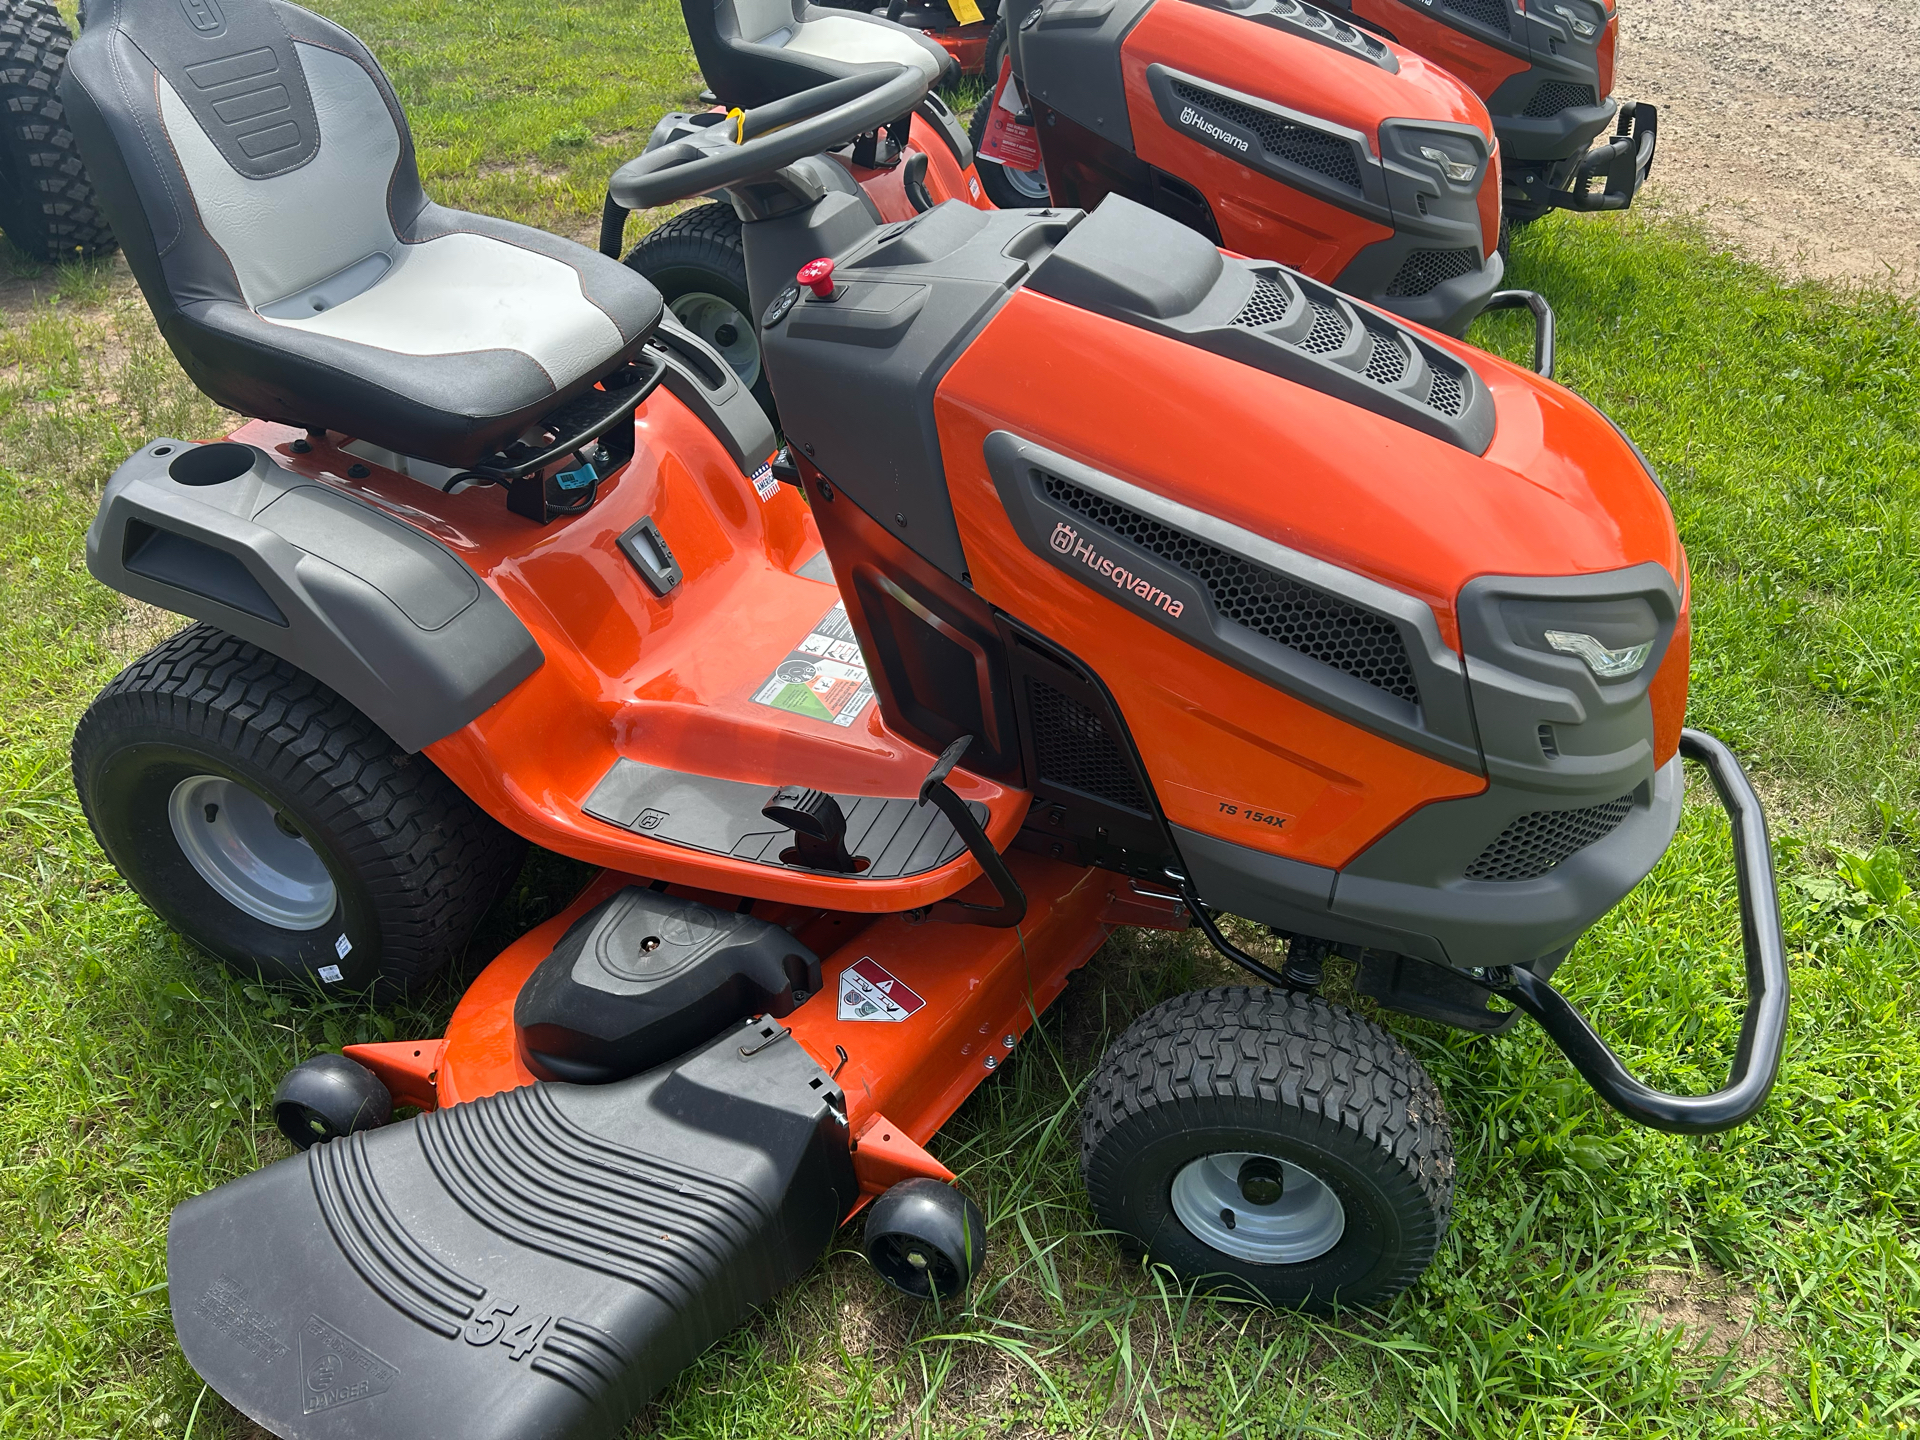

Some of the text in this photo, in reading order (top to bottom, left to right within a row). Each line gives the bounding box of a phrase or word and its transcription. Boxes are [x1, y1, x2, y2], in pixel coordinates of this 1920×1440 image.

[1191, 114, 1249, 152] Husqvarna
[757, 474, 774, 491] AMERIC
[1072, 538, 1184, 618] Husqvarna
[1219, 802, 1286, 828] TS 154X
[464, 1297, 551, 1361] 54
[309, 1380, 368, 1410] DANGER
